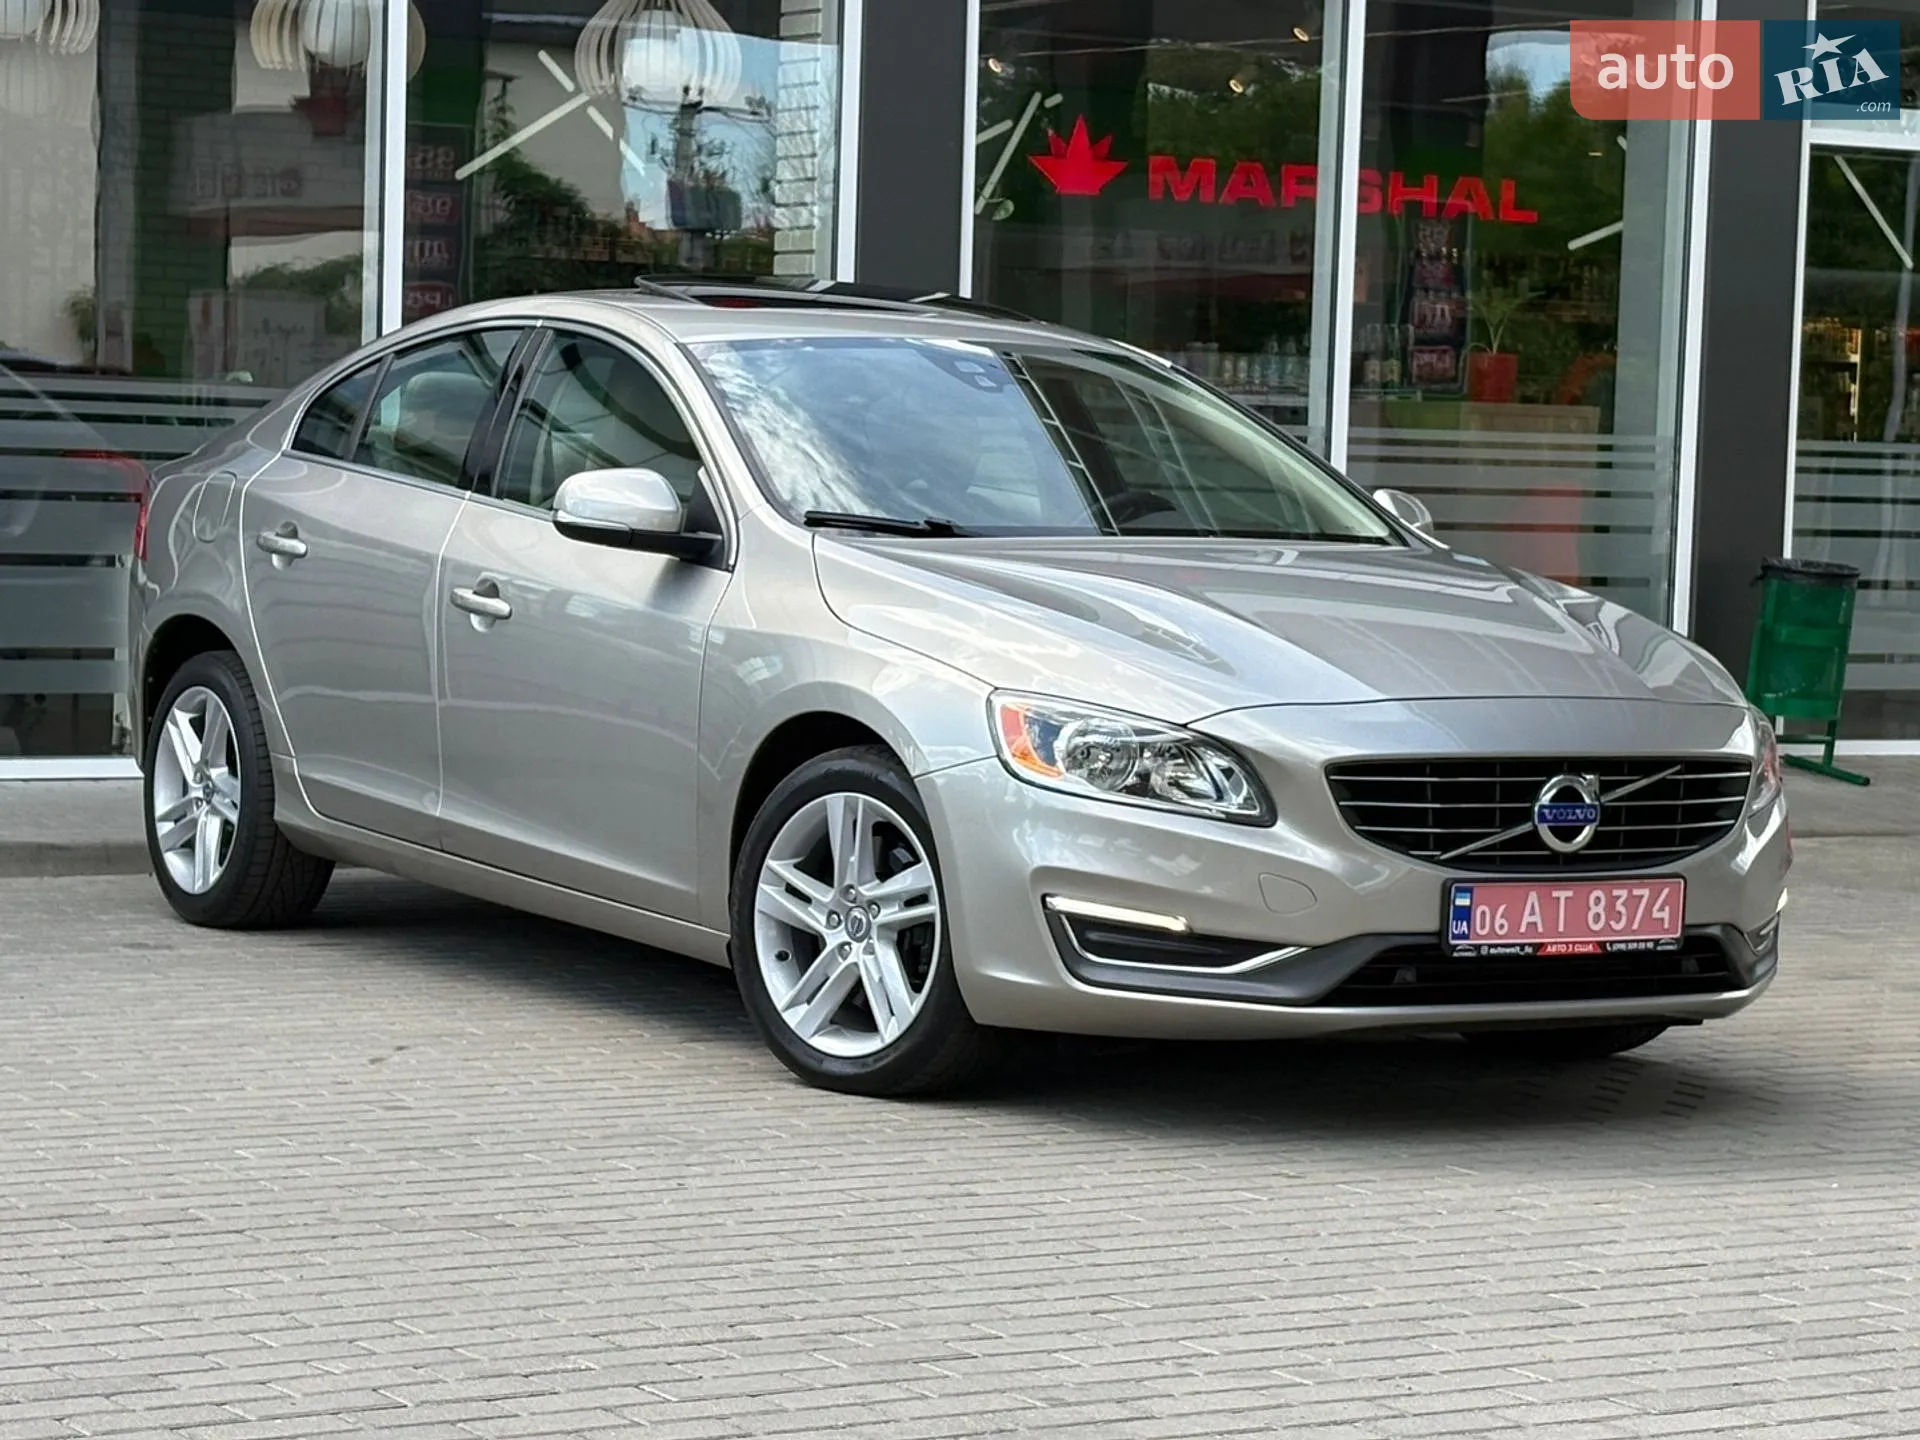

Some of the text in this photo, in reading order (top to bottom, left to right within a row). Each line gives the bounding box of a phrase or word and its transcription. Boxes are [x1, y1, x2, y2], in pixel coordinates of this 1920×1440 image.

[1541, 807, 1596, 820] VOLVO
[1475, 887, 1671, 936] 06 AT 8374
[1452, 919, 1469, 935] UA
